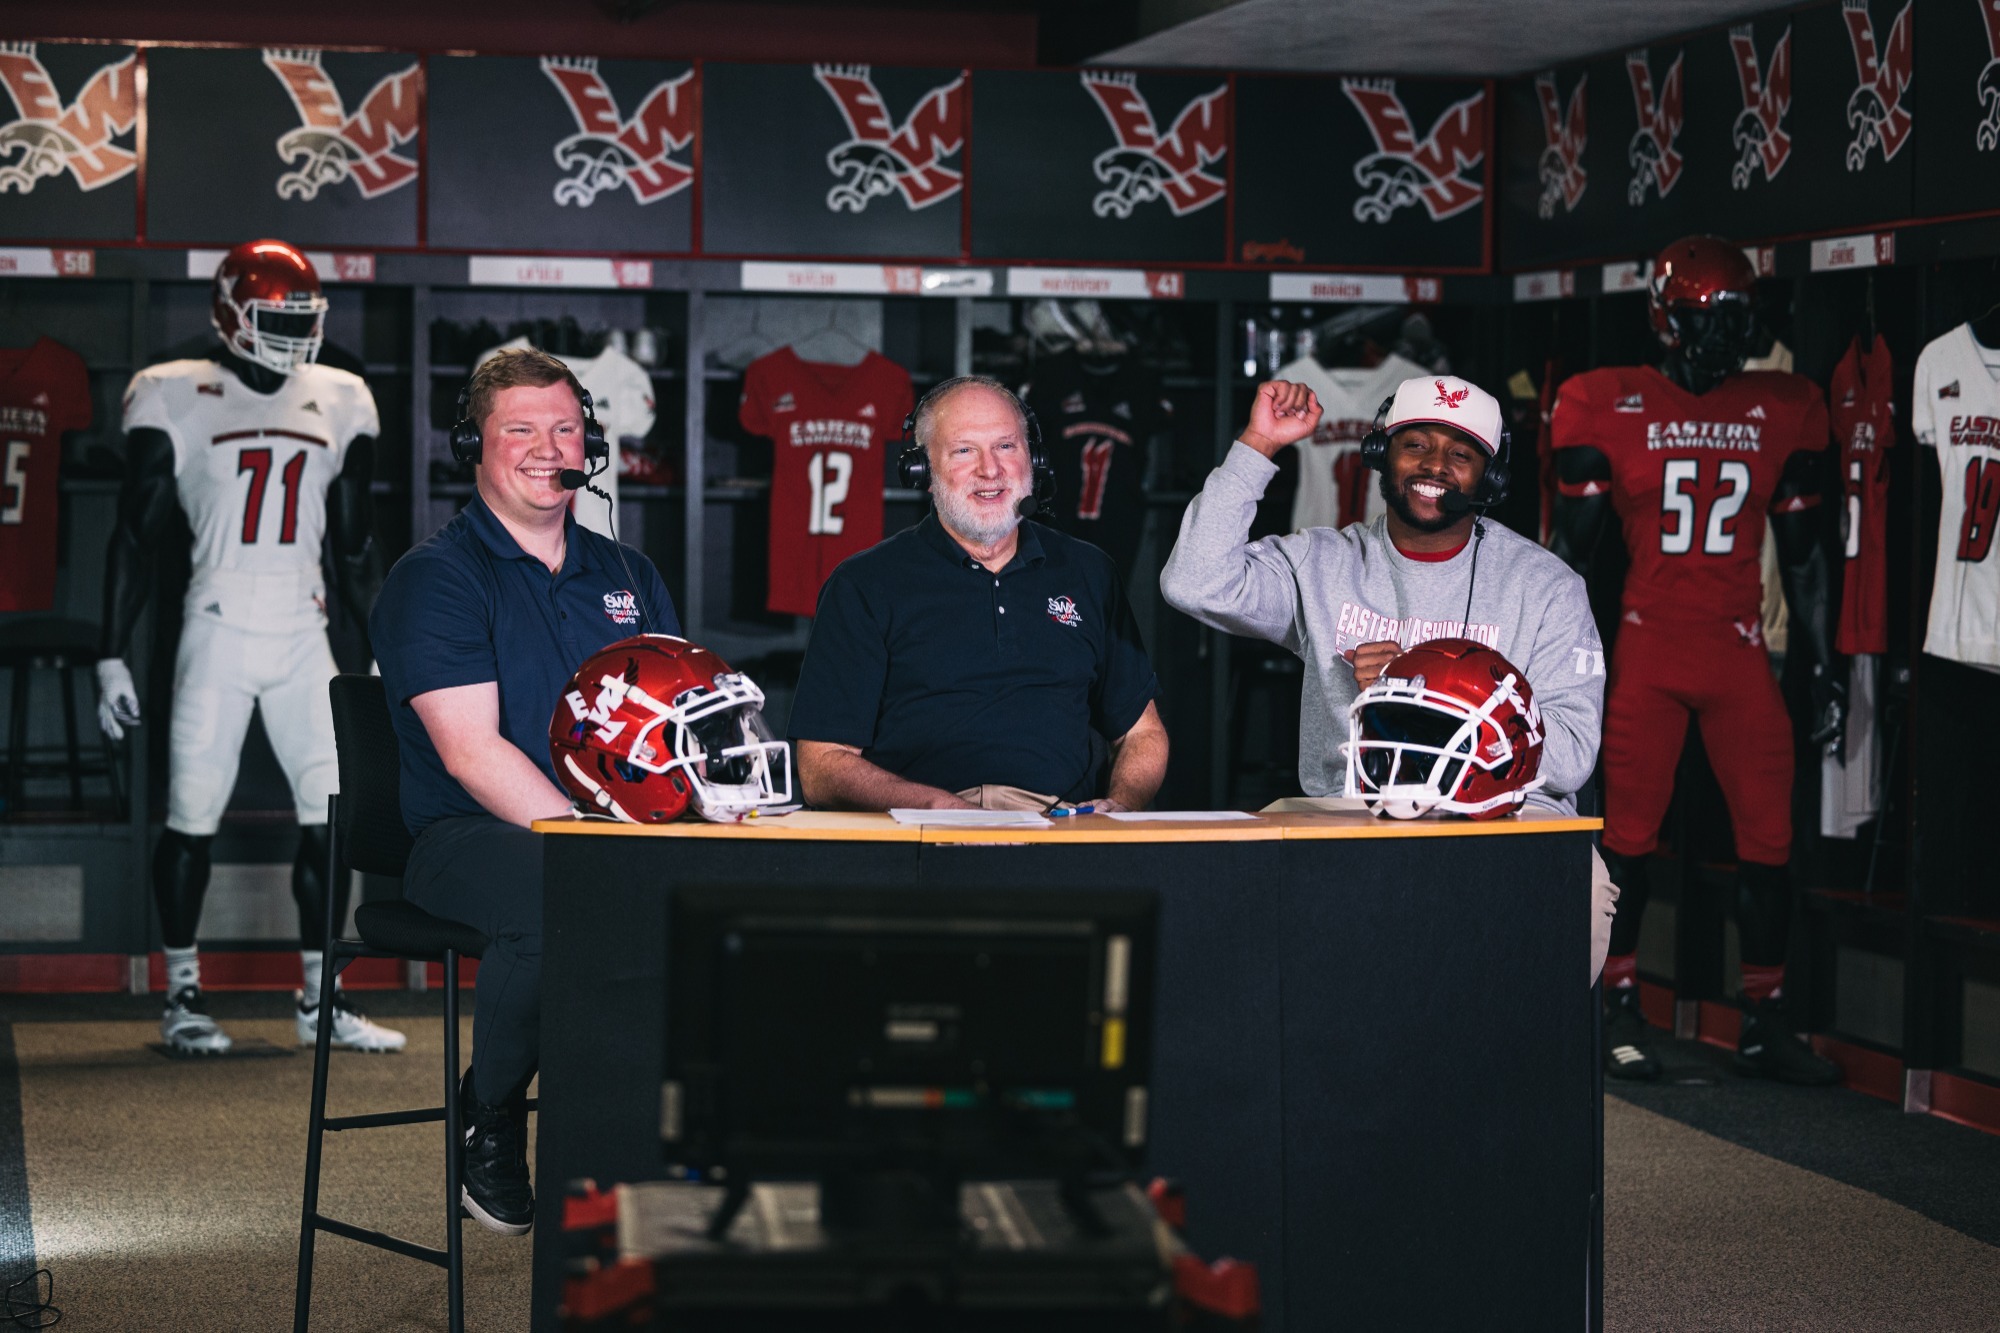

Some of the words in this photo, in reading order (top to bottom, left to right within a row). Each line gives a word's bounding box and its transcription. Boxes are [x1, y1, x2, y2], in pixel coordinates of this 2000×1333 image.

[1156, 273, 1179, 296] 41
[1647, 421, 1760, 439] EASTERN
[1647, 437, 1760, 452] WASHINGTON
[237, 447, 308, 544] 71
[808, 451, 853, 535] 12
[1660, 458, 1751, 555] 52
[603, 593, 636, 609] SWX
[1048, 597, 1078, 615] SWX
[1336, 602, 1408, 648] EASTERN
